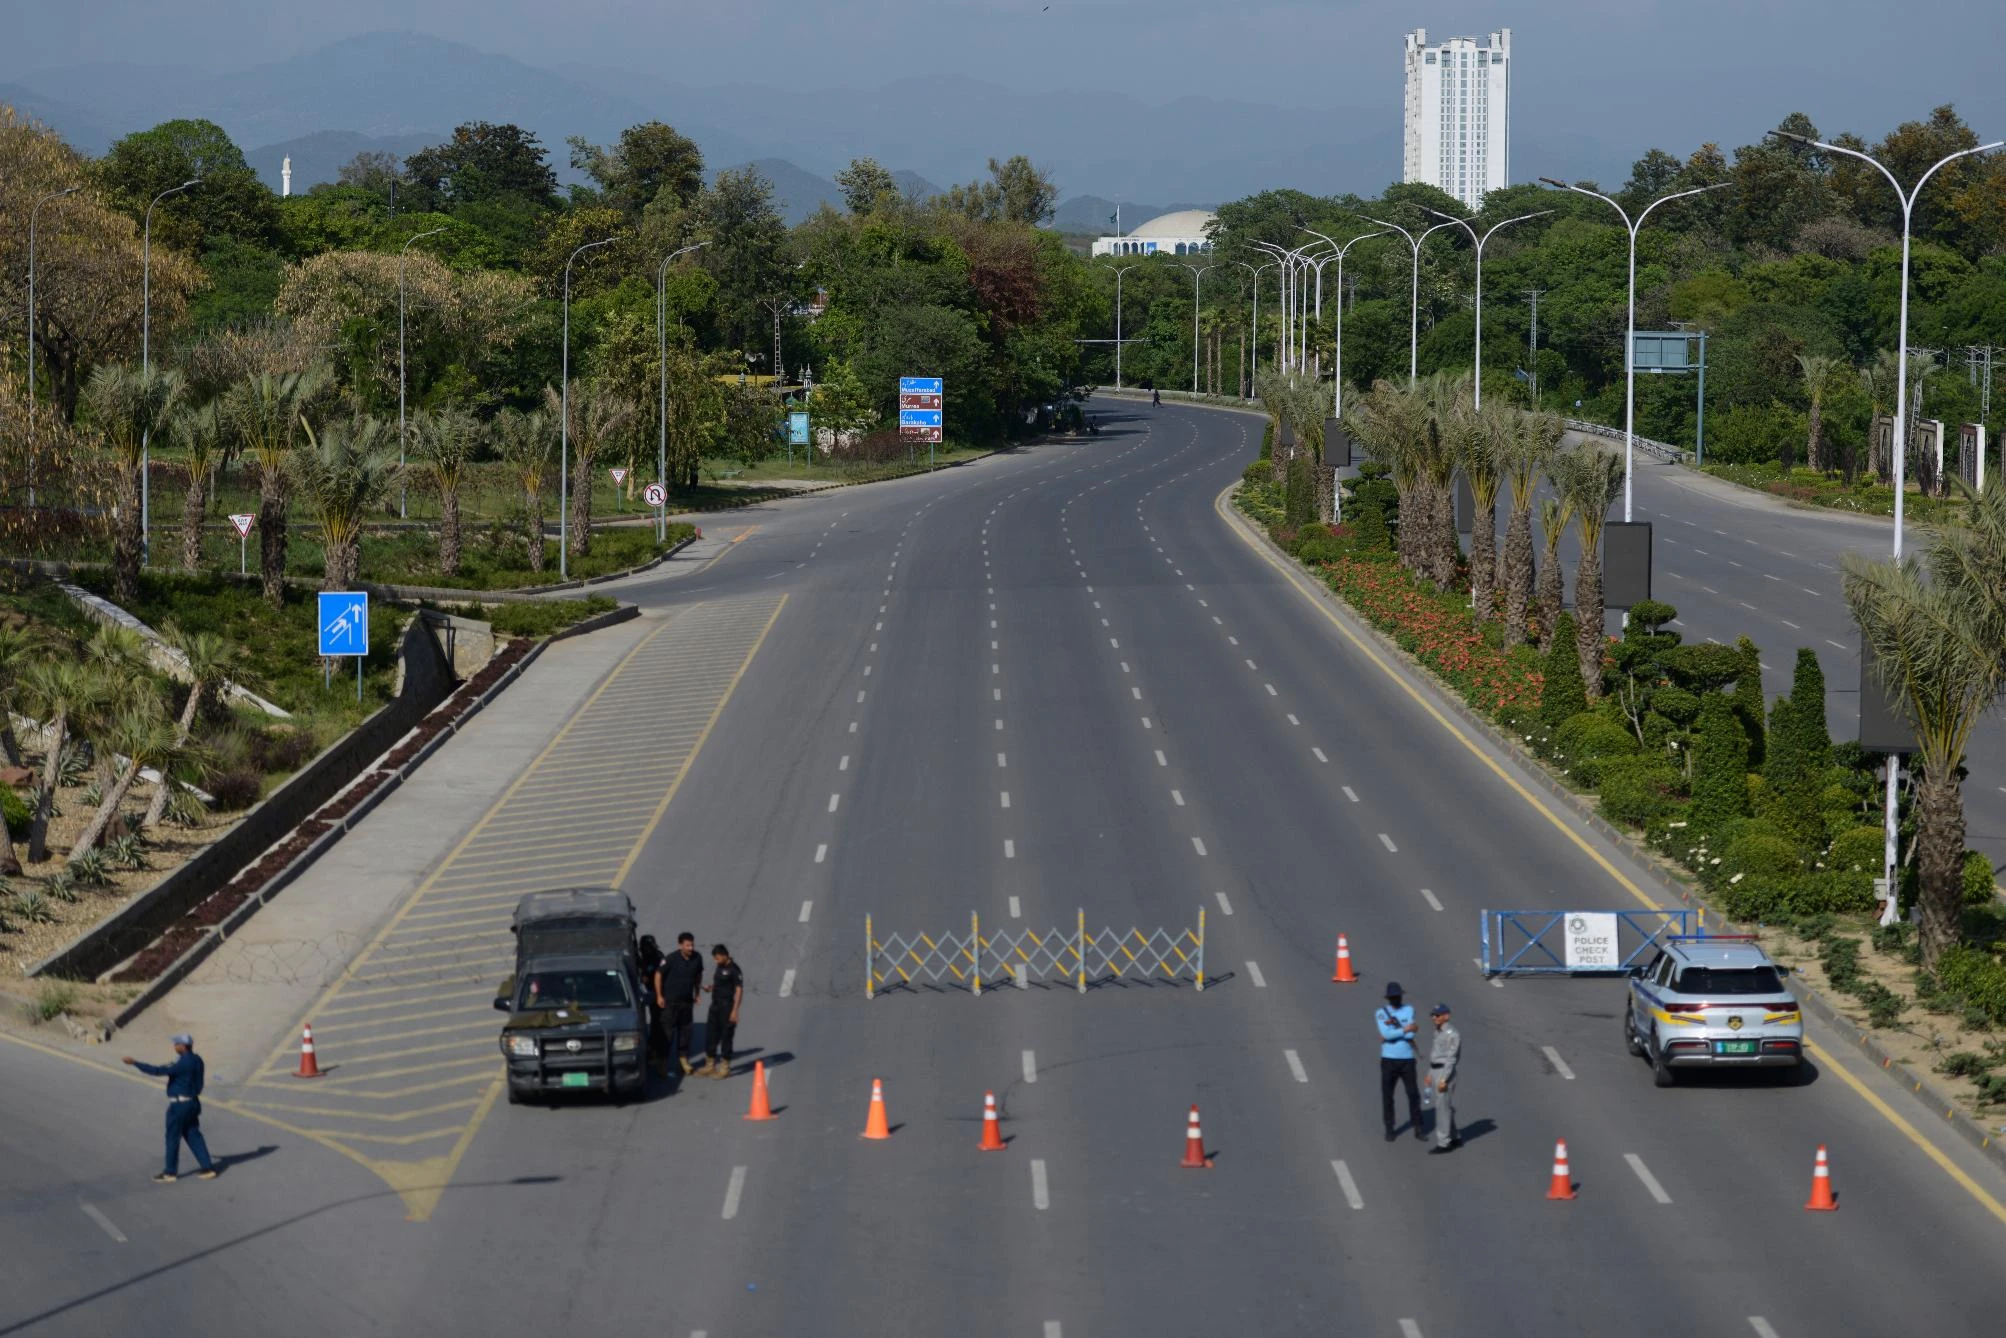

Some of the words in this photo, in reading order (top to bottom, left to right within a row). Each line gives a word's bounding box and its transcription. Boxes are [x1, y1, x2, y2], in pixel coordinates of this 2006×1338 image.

[1574, 937, 1609, 945] POLICE
[1575, 946, 1609, 954] CHECK
[1579, 955, 1605, 963] POST
